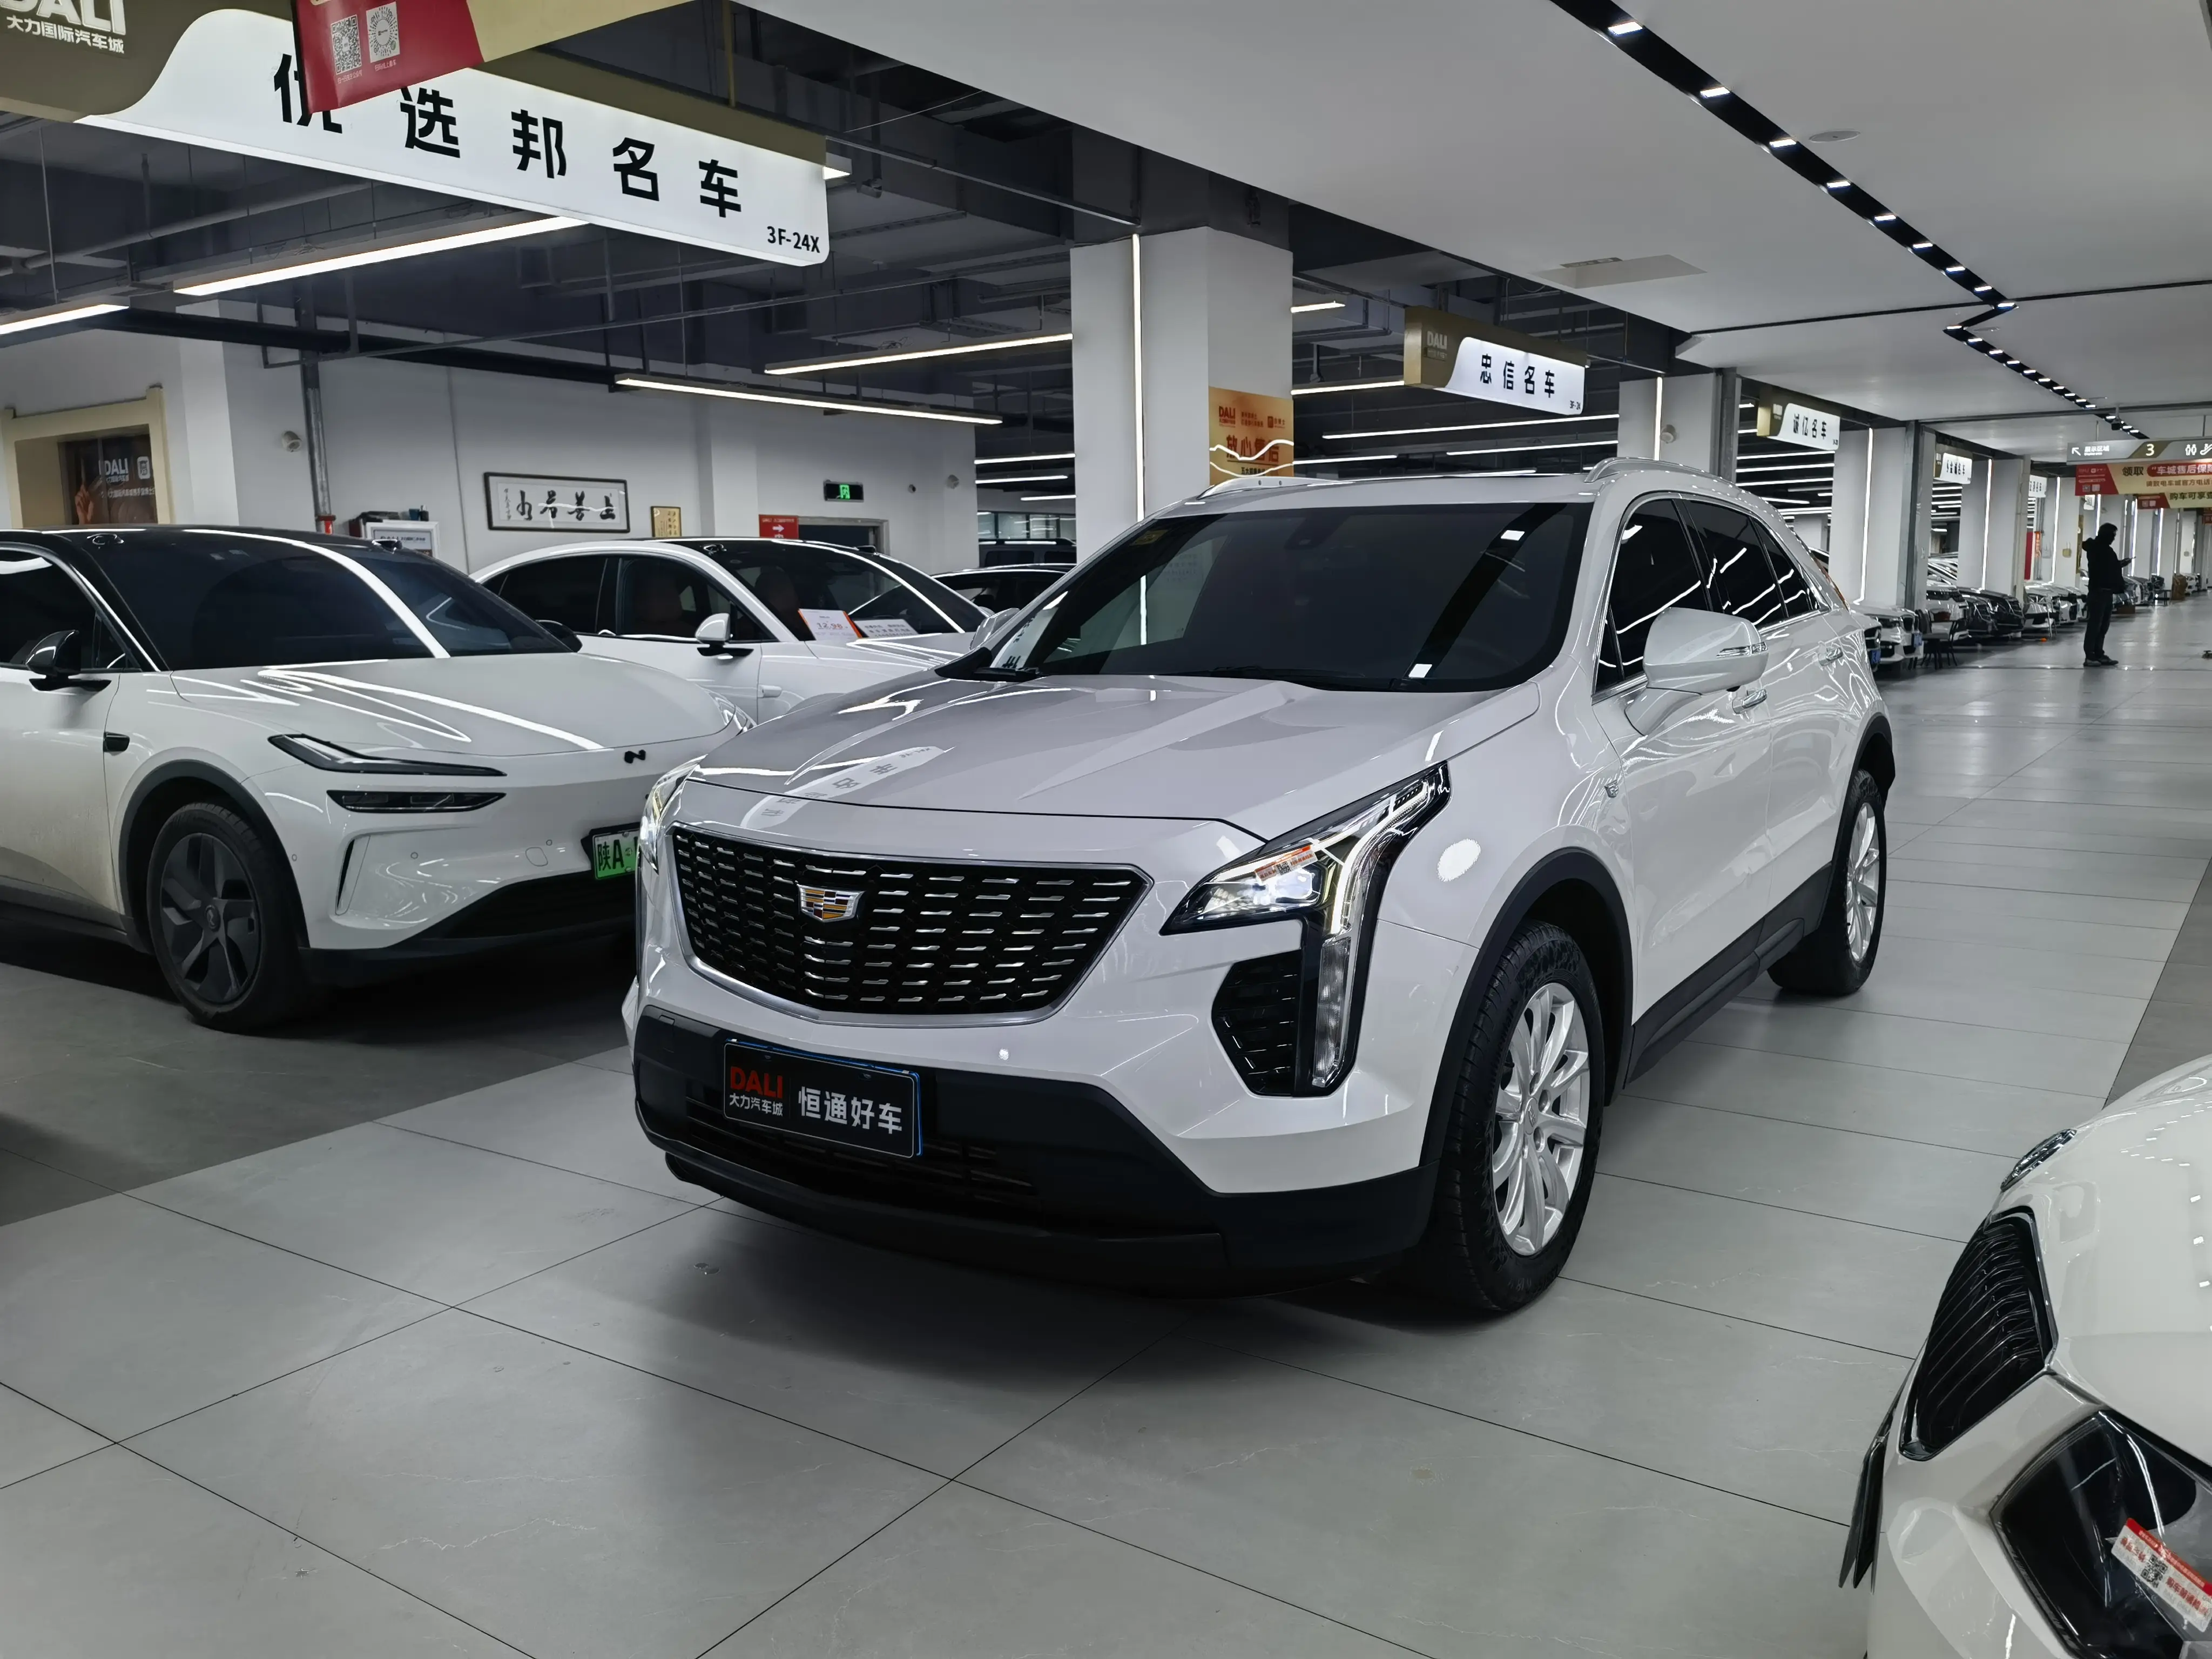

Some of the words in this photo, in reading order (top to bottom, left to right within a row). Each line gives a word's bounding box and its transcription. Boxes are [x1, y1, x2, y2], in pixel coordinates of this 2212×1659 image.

[6, 15, 125, 54] 大力国际汽车城
[767, 226, 821, 254] 3F-24X
[1426, 331, 1448, 350] DALI
[1480, 353, 1555, 399] 忠信名车
[1218, 406, 1236, 419] DALI
[2145, 443, 2155, 457] 3
[104, 458, 129, 476] DALI
[2122, 466, 2144, 476] 领取
[730, 1066, 783, 1099] DALI
[729, 1092, 783, 1117] 大力汽车城
[798, 1086, 902, 1135] 恒通好车
